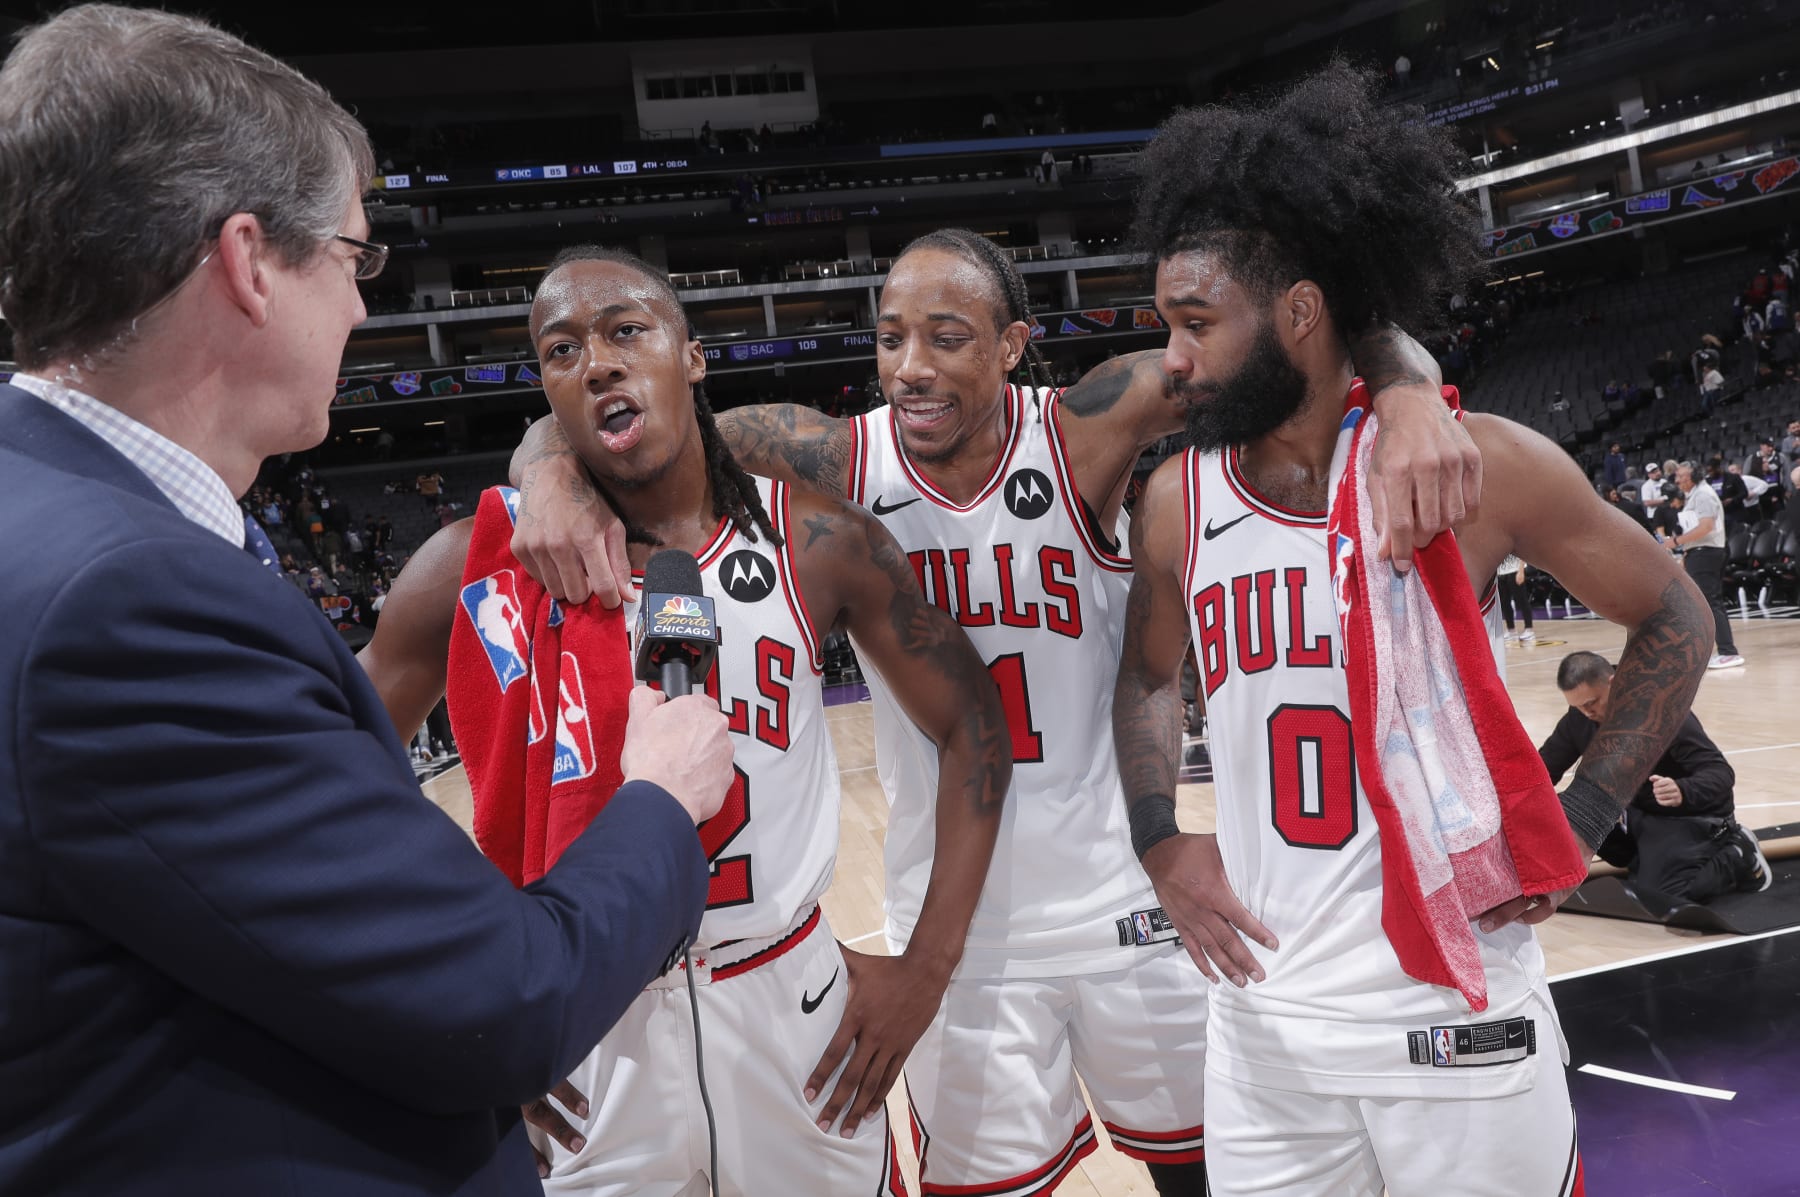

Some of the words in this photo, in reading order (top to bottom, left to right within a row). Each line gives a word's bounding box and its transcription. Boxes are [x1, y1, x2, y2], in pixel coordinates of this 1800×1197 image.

[1545, 78, 1559, 89] PM
[583, 164, 601, 174] LAL
[618, 163, 634, 172] 107
[642, 161, 657, 169] 4TH
[511, 168, 532, 179] OKC
[550, 167, 562, 176] 85
[389, 177, 407, 187] 127
[425, 174, 449, 183] FINAL
[798, 340, 817, 350] 109
[843, 335, 874, 346] FINAL
[704, 349, 721, 360] 113
[751, 344, 774, 355] SAC
[654, 611, 711, 627] Sports
[653, 625, 711, 636] CHICAGO
[1193, 567, 1347, 700] BUL
[553, 753, 575, 773] BA
[1267, 703, 1358, 850] 0
